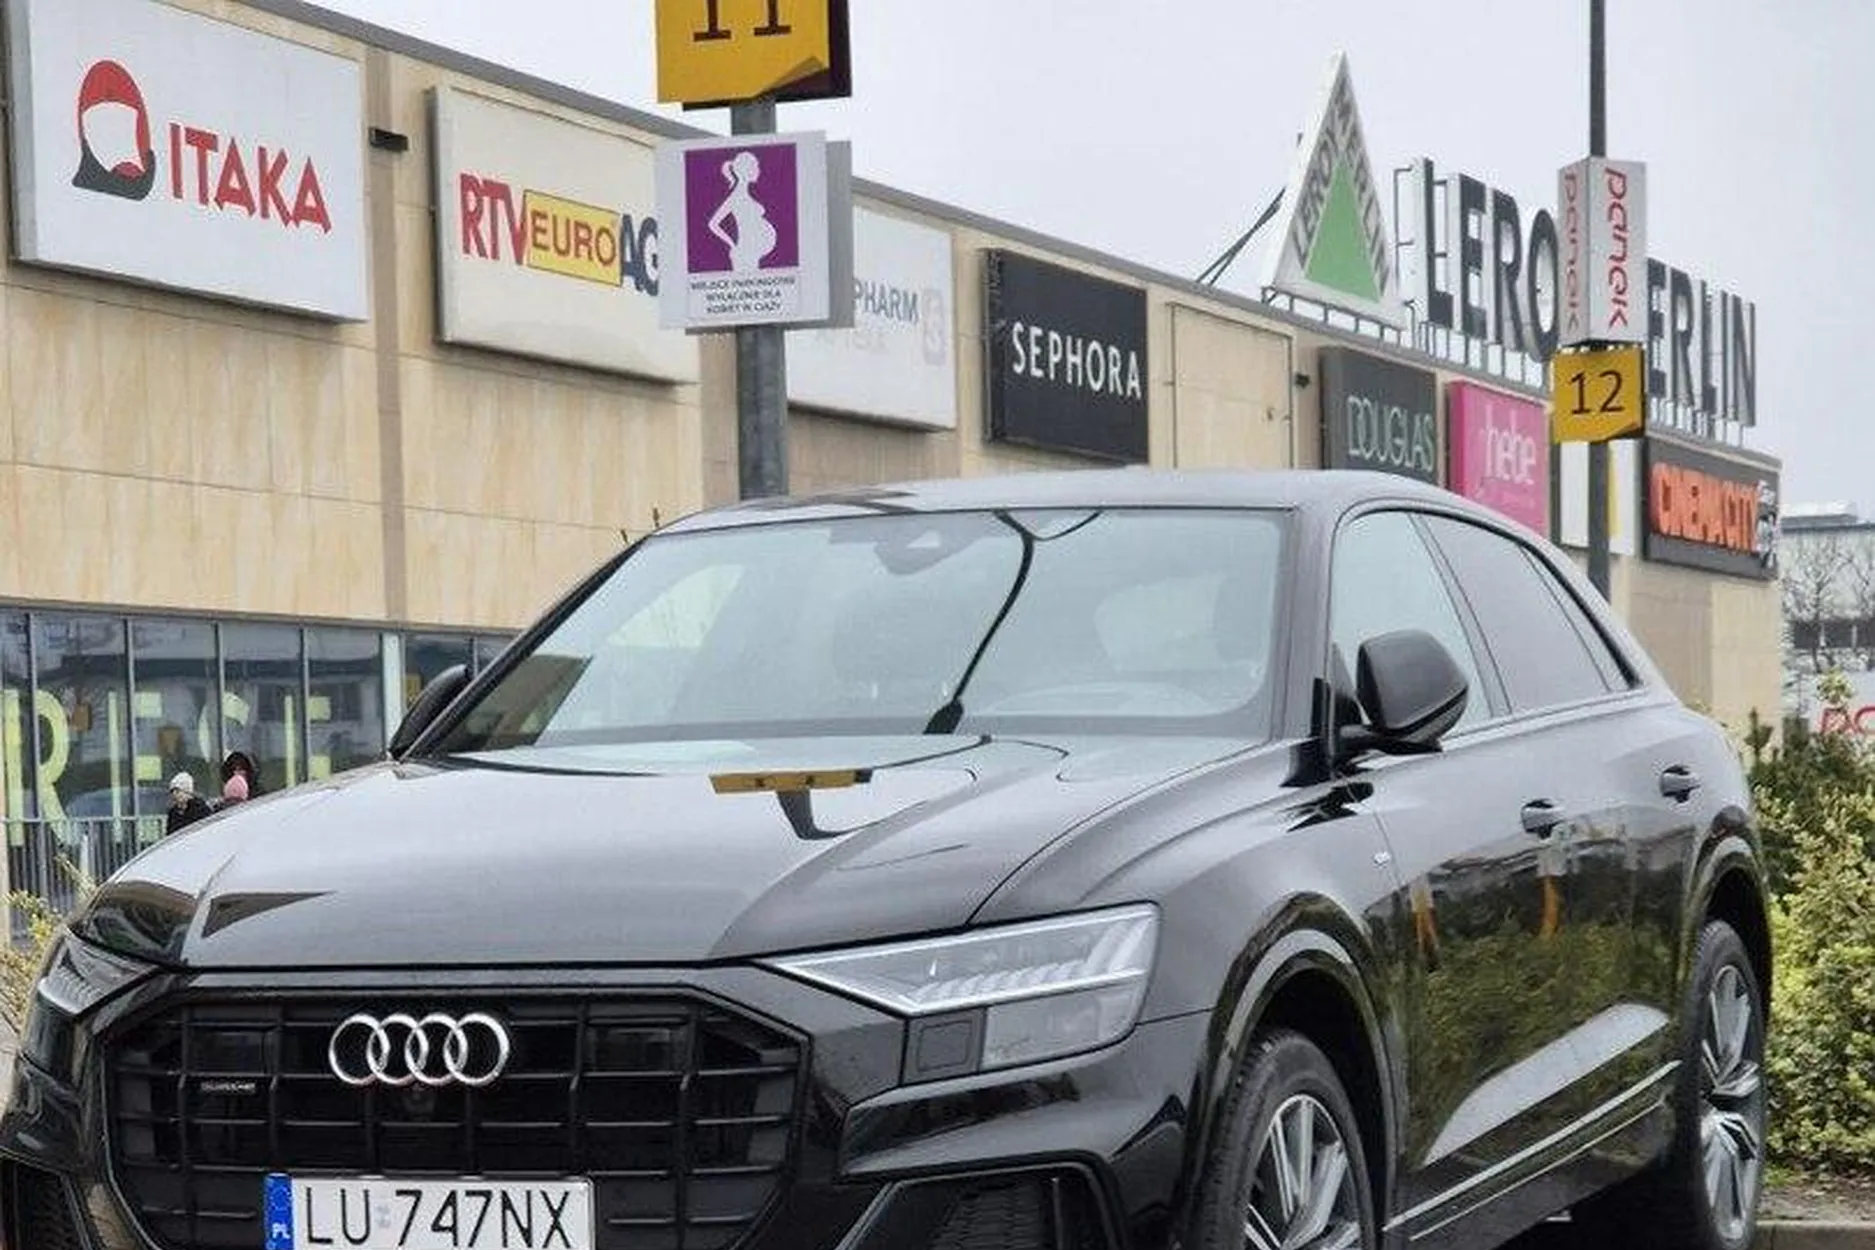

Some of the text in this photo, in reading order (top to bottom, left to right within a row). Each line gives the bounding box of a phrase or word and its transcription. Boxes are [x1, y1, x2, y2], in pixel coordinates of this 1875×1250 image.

[169, 122, 332, 235] ITAKA
[460, 172, 660, 297] RTV EURO AG
[1604, 166, 1629, 329] panek
[1423, 157, 1756, 428] LERO ERLIN
[1012, 320, 1142, 400] SEPHORA
[1569, 369, 1626, 416] 12
[1347, 395, 1435, 473] DOUGLAS
[1486, 403, 1536, 486] hebe
[271, 1222, 291, 1240] PL
[306, 1187, 572, 1250] LU 747NX
